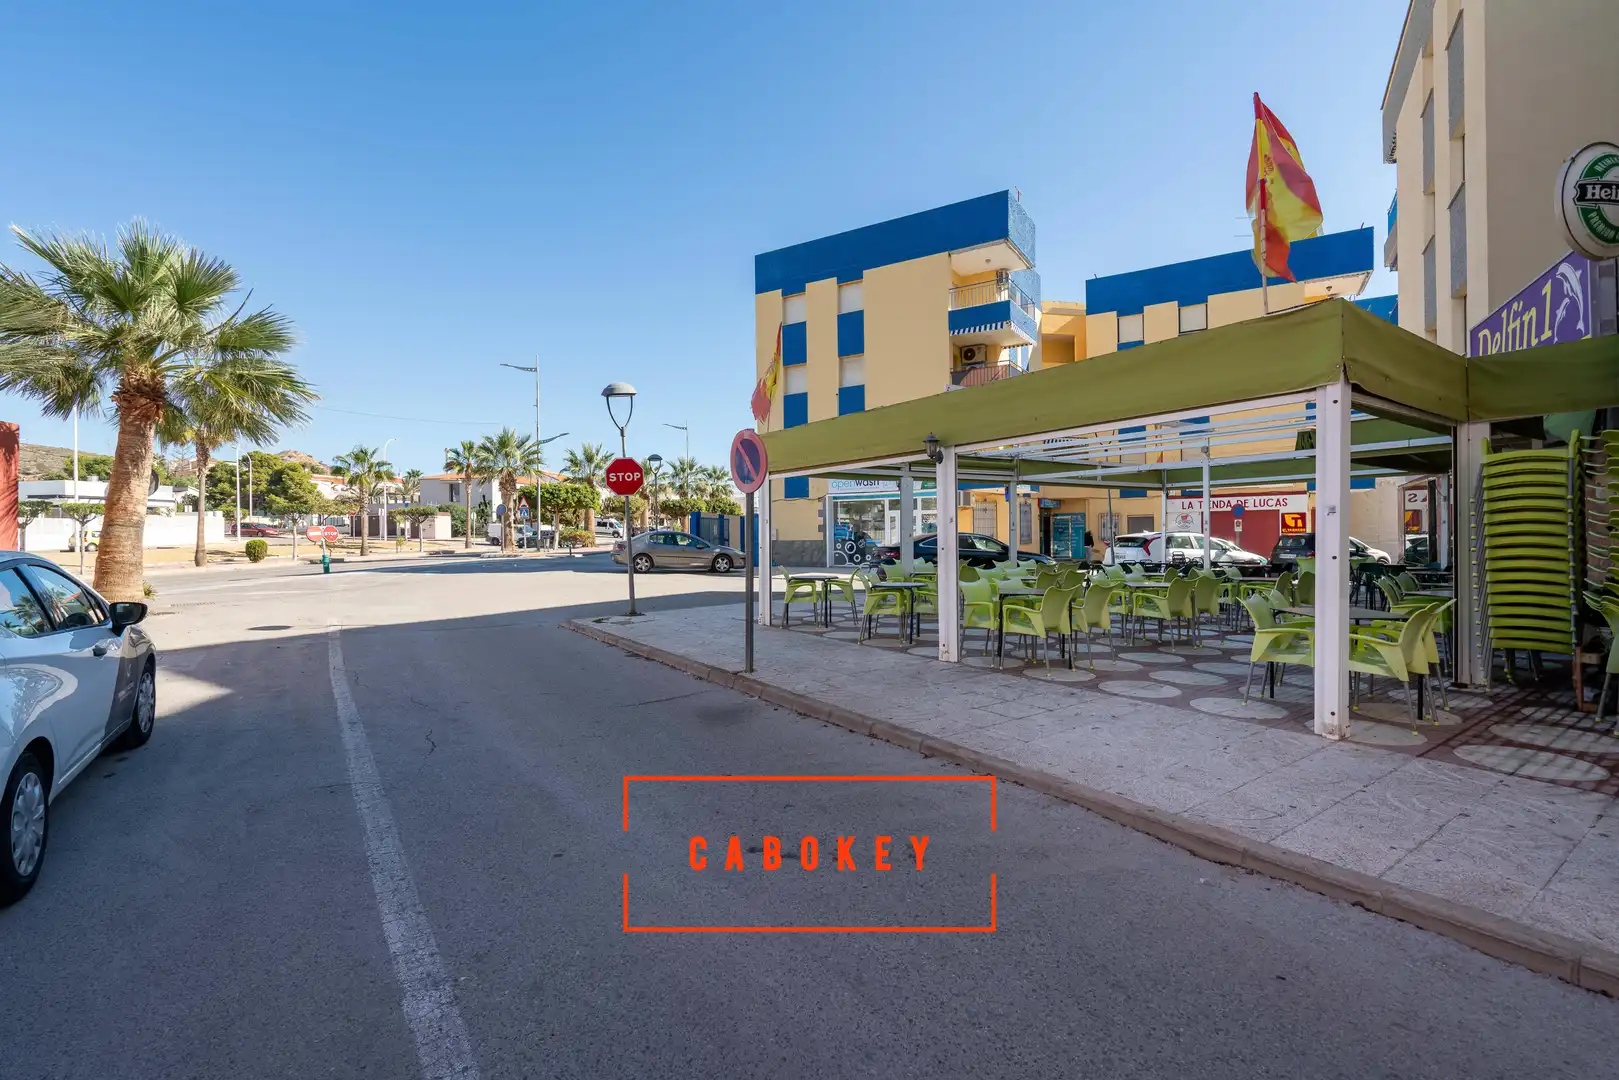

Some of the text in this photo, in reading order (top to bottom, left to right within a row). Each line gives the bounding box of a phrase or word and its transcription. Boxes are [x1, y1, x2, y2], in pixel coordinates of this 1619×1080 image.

[609, 472, 641, 482] STOP
[1181, 497, 1288, 510] LA TNDA DE LUCAS
